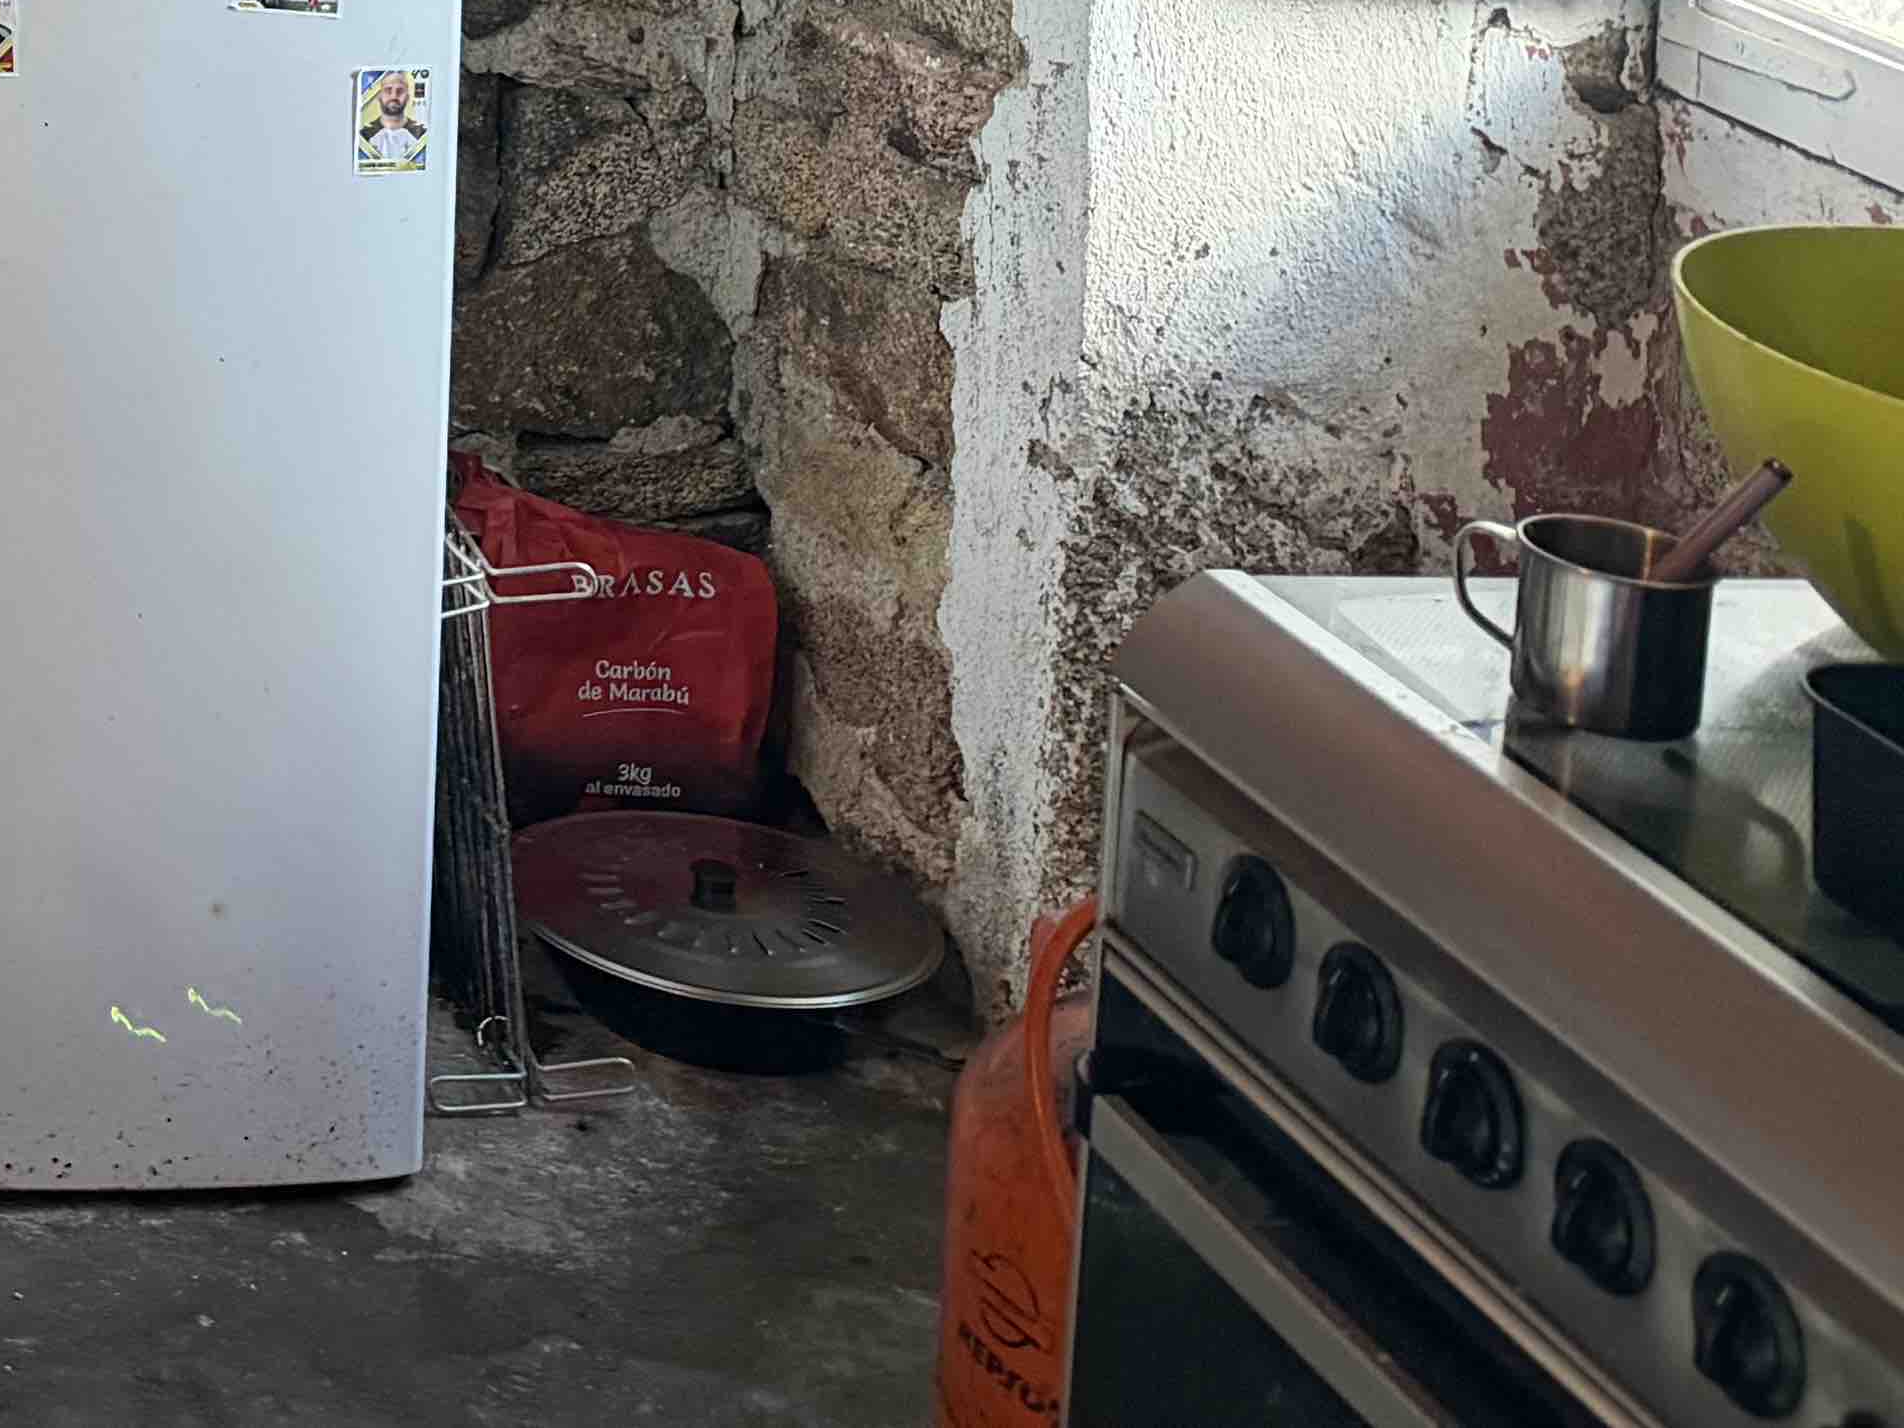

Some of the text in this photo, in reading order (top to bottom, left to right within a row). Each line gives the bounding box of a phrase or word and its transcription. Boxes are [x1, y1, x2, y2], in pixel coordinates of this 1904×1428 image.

[571, 569, 717, 599] BRASAS
[595, 659, 672, 681] Carbón
[577, 679, 690, 706] de Marabú
[617, 762, 653, 786] 3kg
[585, 780, 682, 799] al envasado
